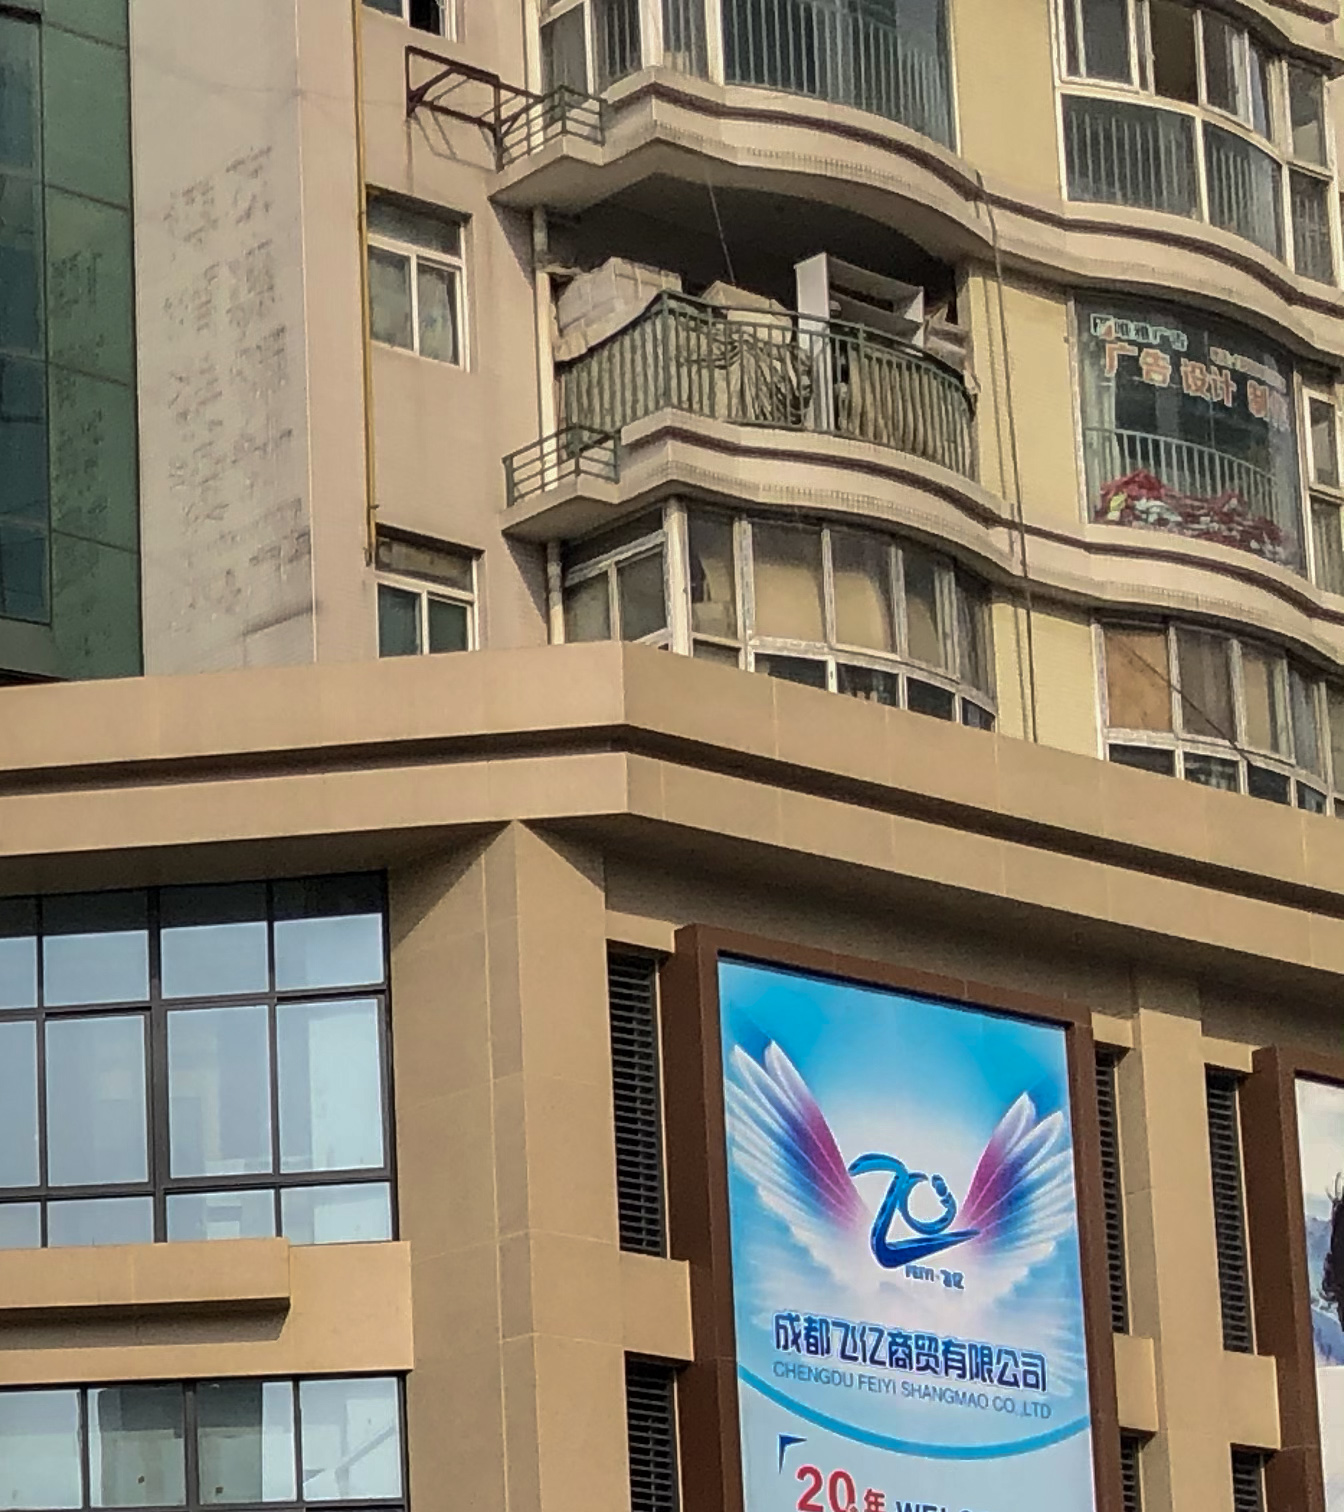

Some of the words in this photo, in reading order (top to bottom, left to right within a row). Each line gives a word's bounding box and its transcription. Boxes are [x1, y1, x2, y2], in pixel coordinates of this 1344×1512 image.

[774, 1312, 1047, 1392] 成都飞亿商贸有限公司
[773, 1361, 853, 1388] CHENGDU
[858, 1374, 897, 1395] FEIYI
[901, 1381, 989, 1409] SHANGMAO
